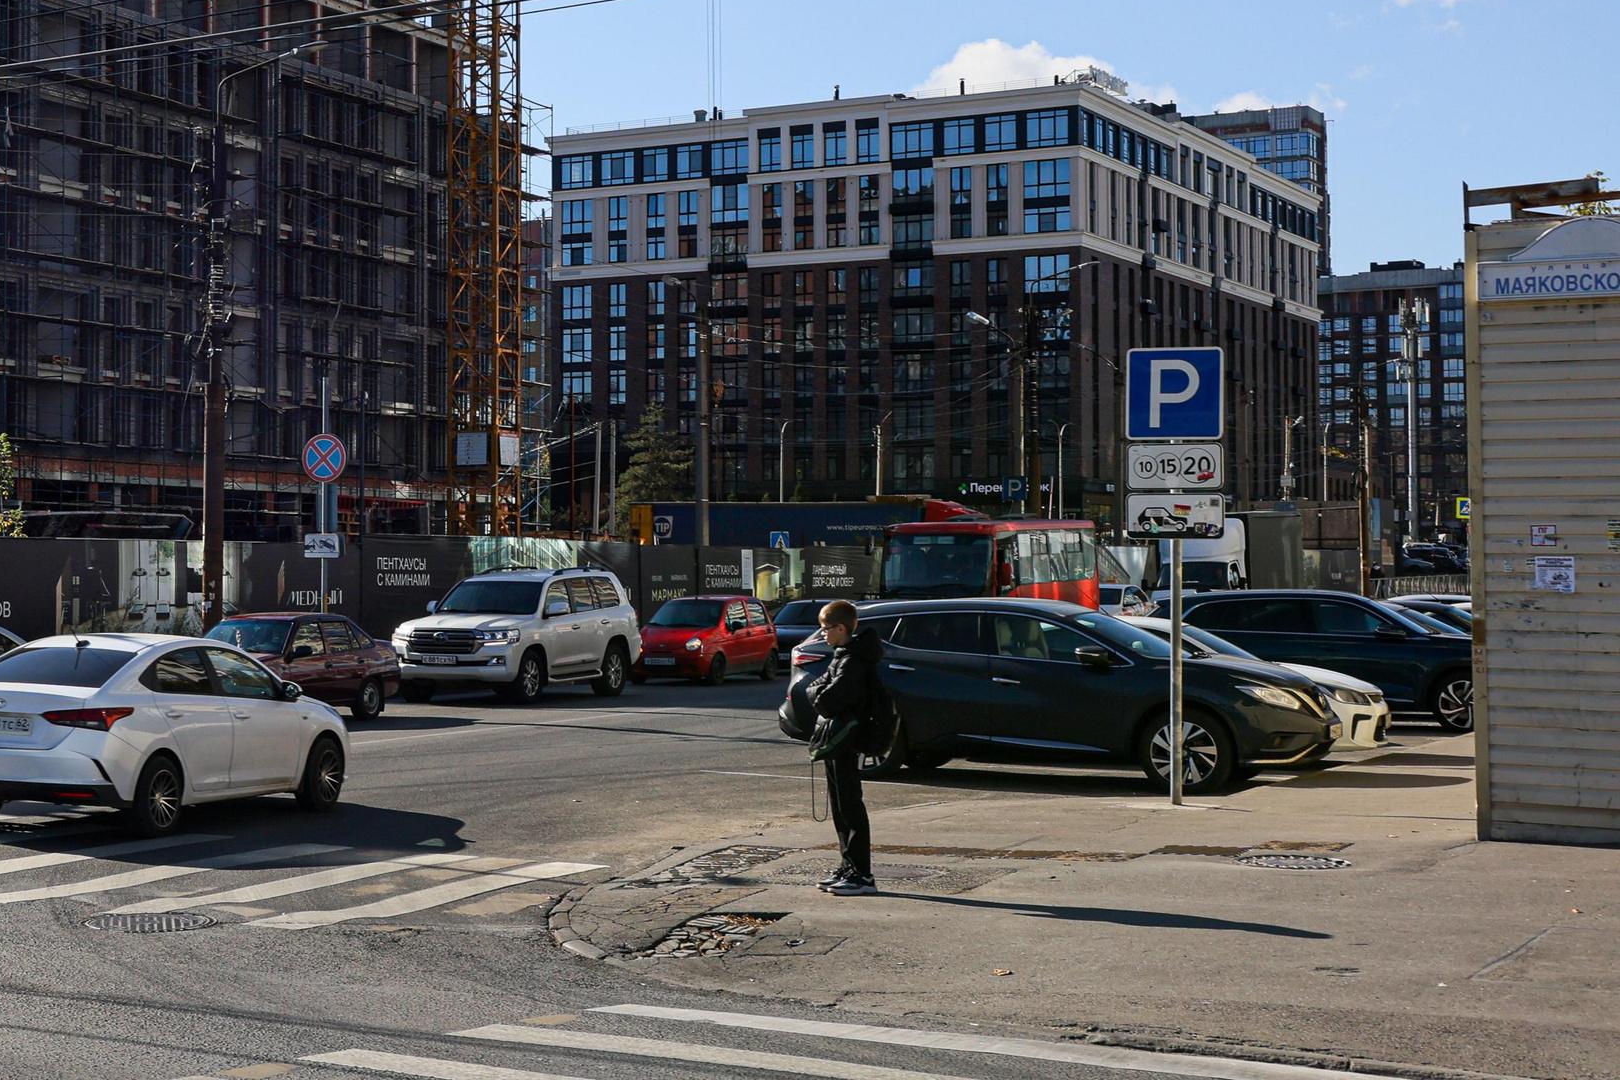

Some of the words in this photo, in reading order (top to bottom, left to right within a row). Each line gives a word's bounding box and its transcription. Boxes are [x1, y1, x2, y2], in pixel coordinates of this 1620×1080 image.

[1495, 272, 1620, 295] МАЯКОВСКО
[1148, 359, 1200, 428] P
[1139, 461, 1153, 473] 10
[1159, 458, 1177, 474] 15
[1183, 456, 1211, 475] 20
[655, 522, 670, 533] TIP
[377, 557, 427, 571] ПЕНТХАУСЫ
[377, 573, 384, 587] С
[384, 573, 431, 587] КАМИНАМИ
